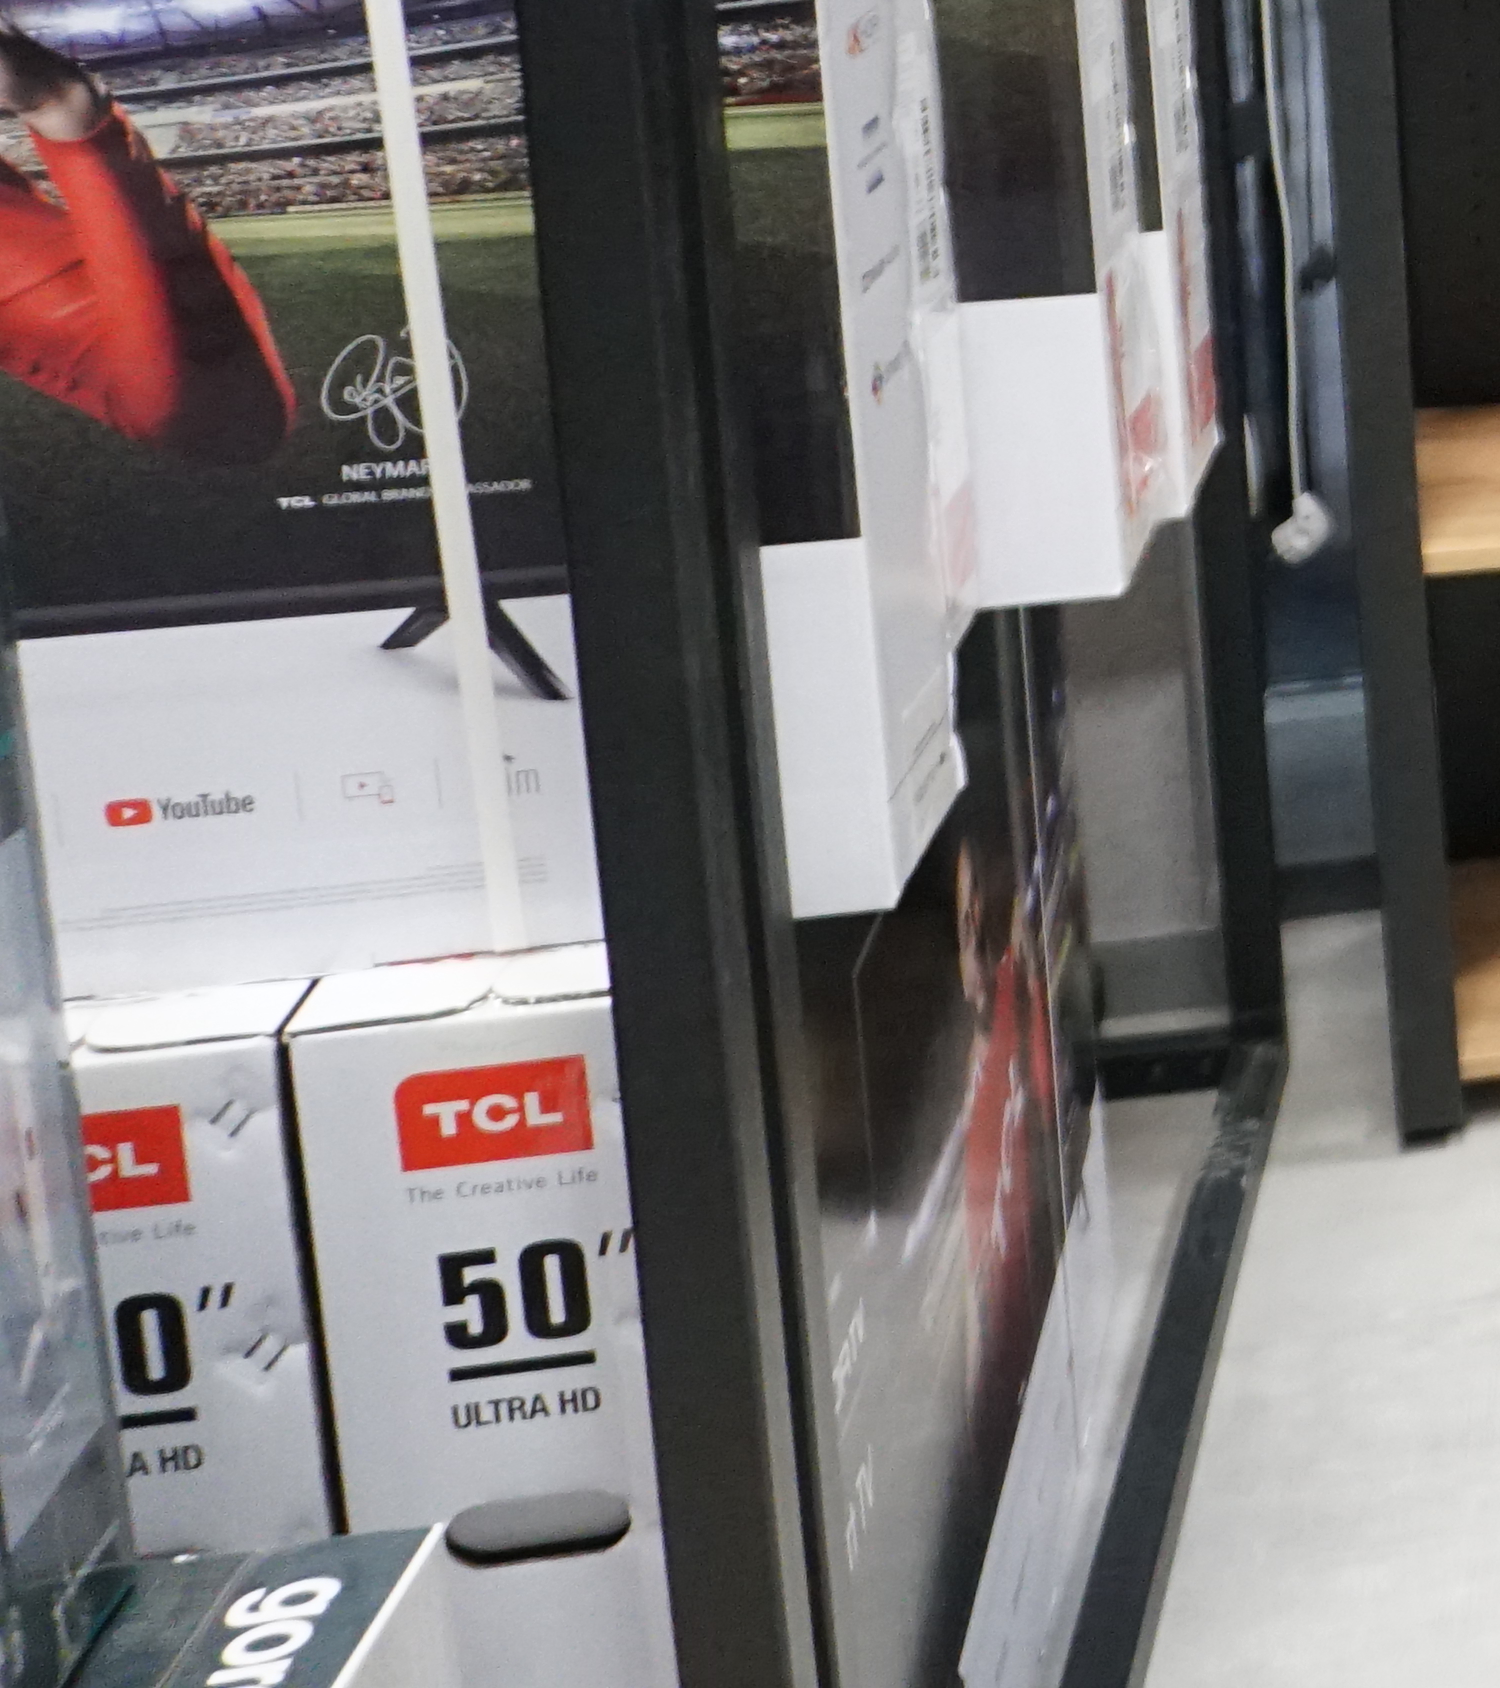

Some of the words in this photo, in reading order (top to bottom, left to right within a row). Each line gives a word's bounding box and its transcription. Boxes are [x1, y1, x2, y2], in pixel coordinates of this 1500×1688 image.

[276, 495, 317, 510] TCL
[156, 791, 256, 820] YouTube
[421, 1091, 564, 1139] TCL
[83, 1141, 161, 1184] CL
[406, 1185, 445, 1205] The
[455, 1173, 548, 1199] Creative
[557, 1166, 599, 1187] Life
[113, 1281, 236, 1397] 0"
[451, 1392, 551, 1430] ULTRA
[557, 1385, 603, 1416] HD
[157, 1443, 205, 1473] HD
